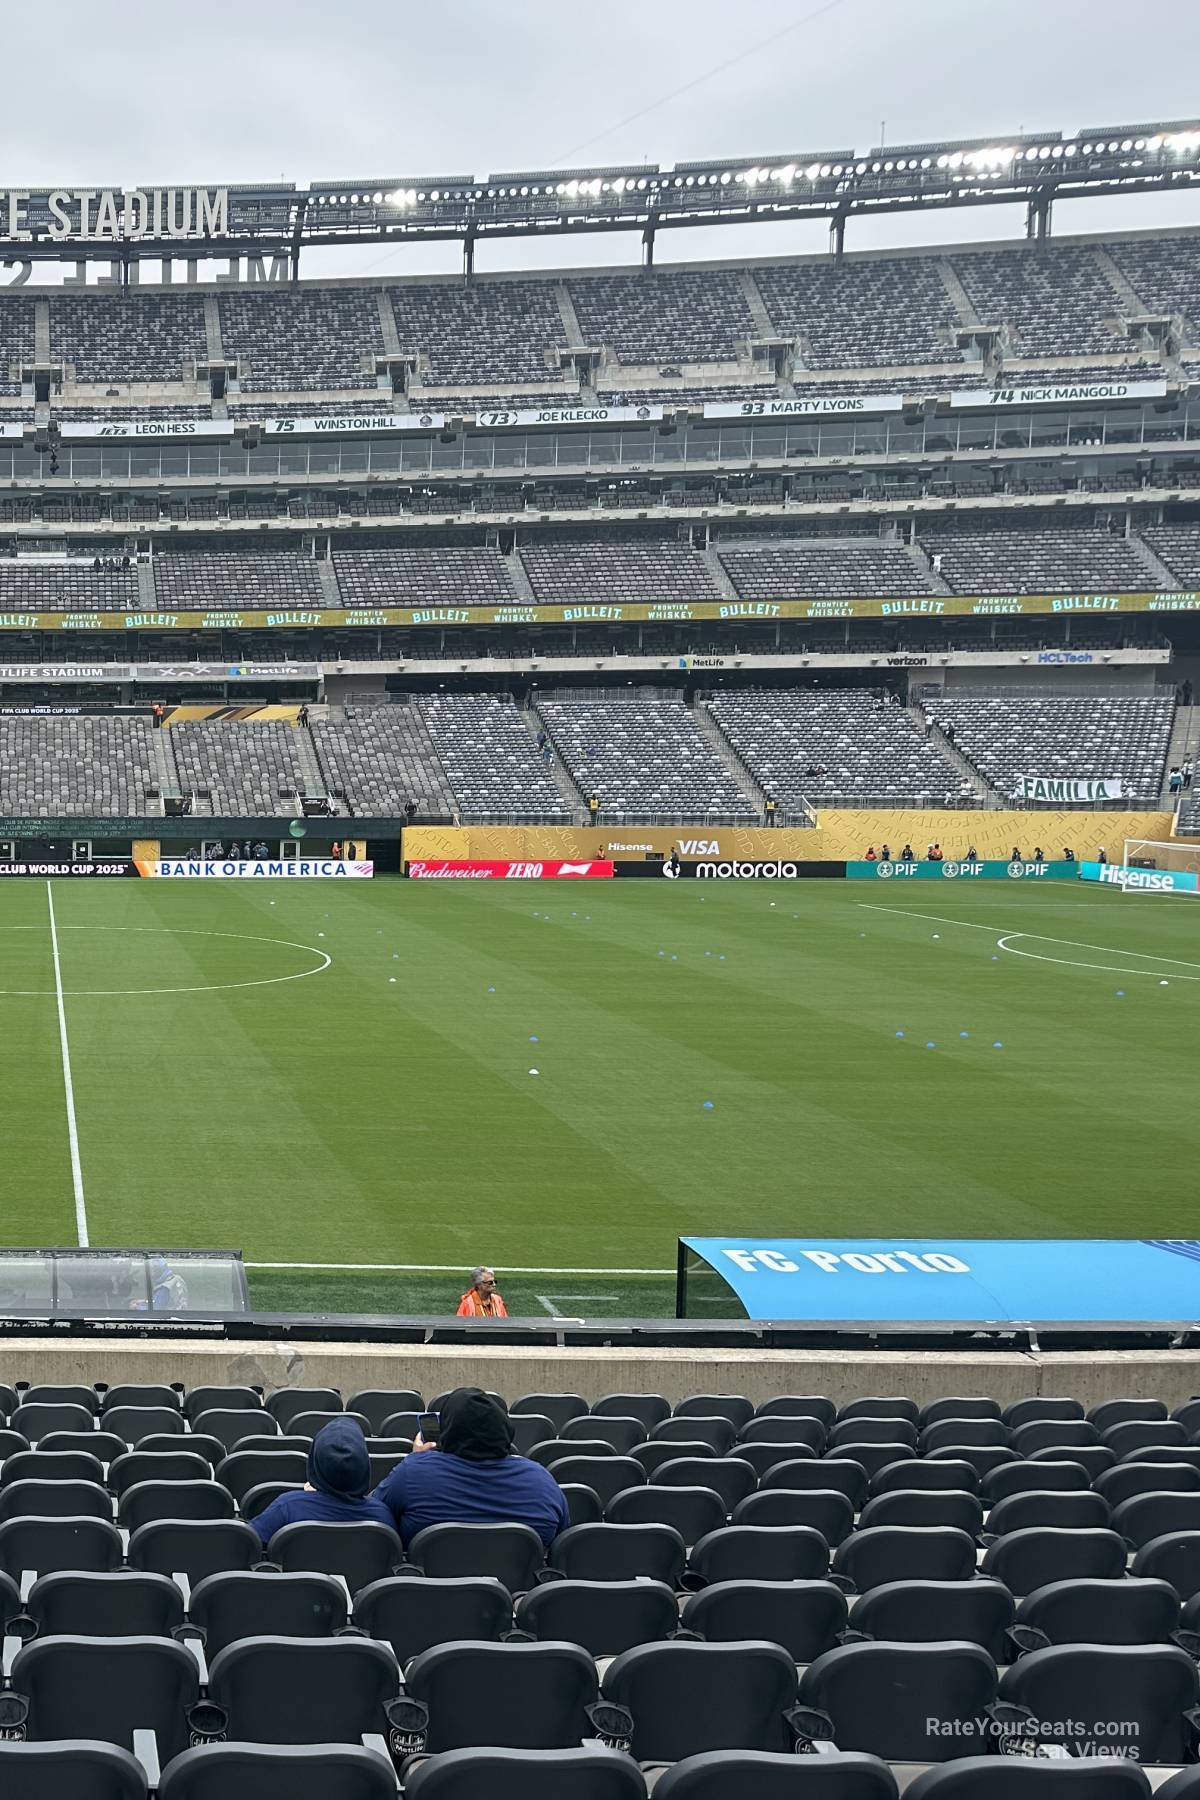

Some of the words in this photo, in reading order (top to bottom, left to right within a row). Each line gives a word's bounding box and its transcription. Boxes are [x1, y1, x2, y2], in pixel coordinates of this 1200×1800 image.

[47, 189, 228, 238] STADIUM
[988, 391, 1014, 403] 74
[1020, 389, 1052, 401] NICK
[1054, 386, 1127, 399] MANGOLD
[741, 403, 765, 415] 93
[770, 401, 821, 413] MARTY
[822, 399, 864, 410] LYONS
[535, 411, 560, 422] JOE
[561, 409, 608, 421] KLECKO
[135, 424, 165, 435] LEON
[167, 423, 195, 434] HESS
[274, 419, 295, 431] 75
[314, 418, 370, 430] WINSTON
[372, 417, 396, 428] HILL
[648, 611, 693, 619] WHISKEY
[807, 608, 853, 616] WHISKEY
[973, 605, 1023, 614] WHISKEY
[61, 620, 102, 628] WHISKEY
[202, 619, 243, 627] WHISKEY
[494, 614, 537, 622] WHISKEY
[692, 658, 725, 667] MetLife
[887, 655, 927, 666] verizon
[1038, 652, 1093, 663] HCLTech
[42, 667, 103, 677] STADIUM
[1023, 778, 1110, 801] FAMILIA
[608, 842, 653, 851] Hisense
[676, 840, 720, 855] VISA
[29, 864, 69, 875] WORLD
[71, 864, 94, 875] CUP
[160, 862, 216, 876] BANK
[222, 862, 248, 876] OF
[253, 862, 348, 876] AMERICA
[408, 861, 493, 878] Budweiser
[505, 862, 544, 878] ZERO
[696, 860, 797, 878] motorola
[895, 863, 919, 875] PIF
[960, 863, 984, 875] PIF
[1025, 863, 1049, 875] PIF
[1099, 864, 1175, 889] Hisense
[719, 1249, 800, 1273] FC
[799, 1249, 971, 1273] Porto
[395, 1744, 425, 1753] MetLife
